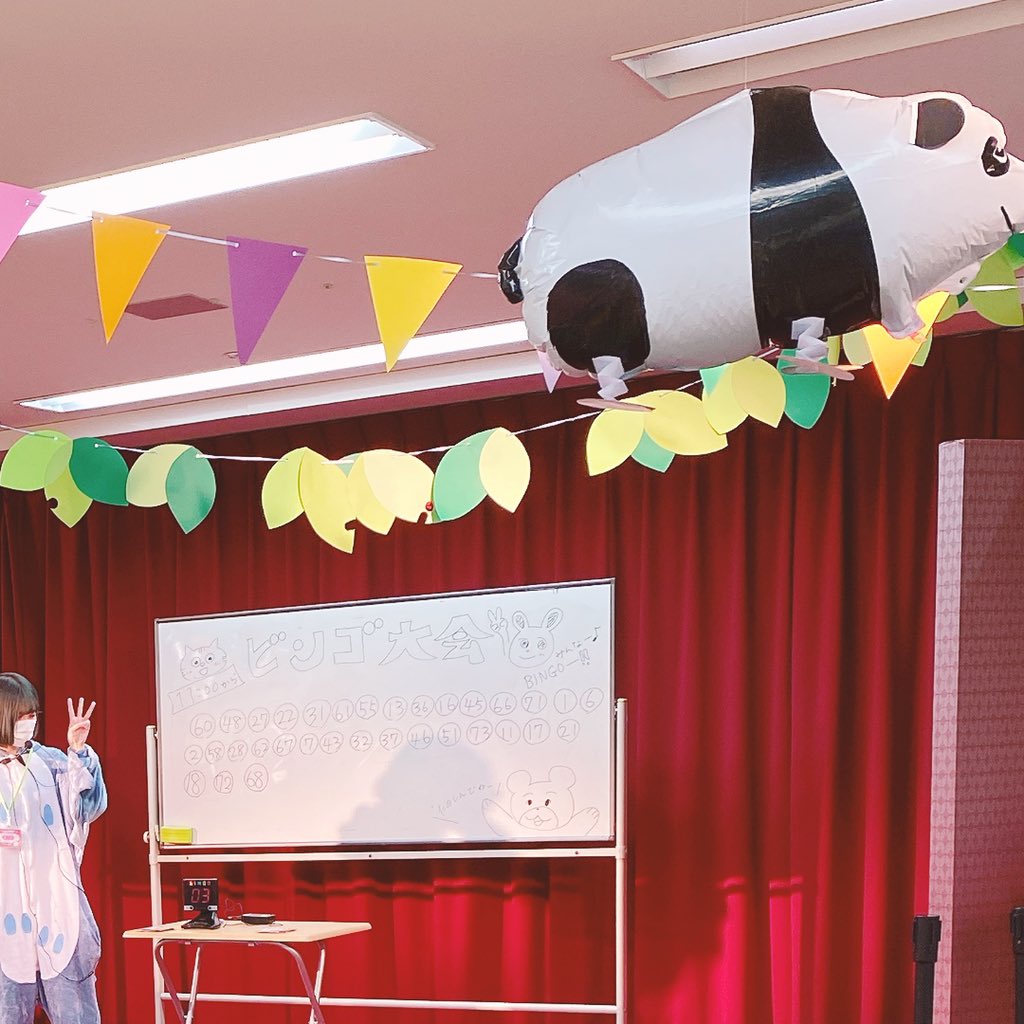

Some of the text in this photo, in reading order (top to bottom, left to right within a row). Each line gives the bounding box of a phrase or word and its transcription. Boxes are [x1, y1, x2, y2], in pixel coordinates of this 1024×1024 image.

[246, 613, 495, 679] ビンゴ大会
[192, 716, 214, 738] 60
[221, 713, 243, 733] 48
[250, 711, 269, 731] 27
[275, 708, 298, 726] 22
[304, 702, 326, 727] 31
[333, 702, 352, 722] 61
[358, 698, 379, 718] 55
[387, 699, 406, 719] 13
[411, 699, 430, 715] 36
[437, 695, 458, 715] 16
[462, 695, 485, 713] 45
[491, 695, 514, 714] 66
[522, 693, 543, 713] 71
[226, 742, 246, 760] 28
[275, 737, 295, 755] 67
[322, 734, 341, 753] 43
[351, 733, 371, 750] 32
[381, 731, 400, 749] 37
[409, 727, 432, 747] 46
[440, 726, 458, 745] 51
[467, 724, 491, 744] 73
[500, 725, 514, 743] 11
[526, 722, 545, 742] 17
[557, 721, 578, 740] 21
[184, 770, 202, 796] 18
[245, 769, 265, 790] 68
[191, 887, 210, 904] 03
